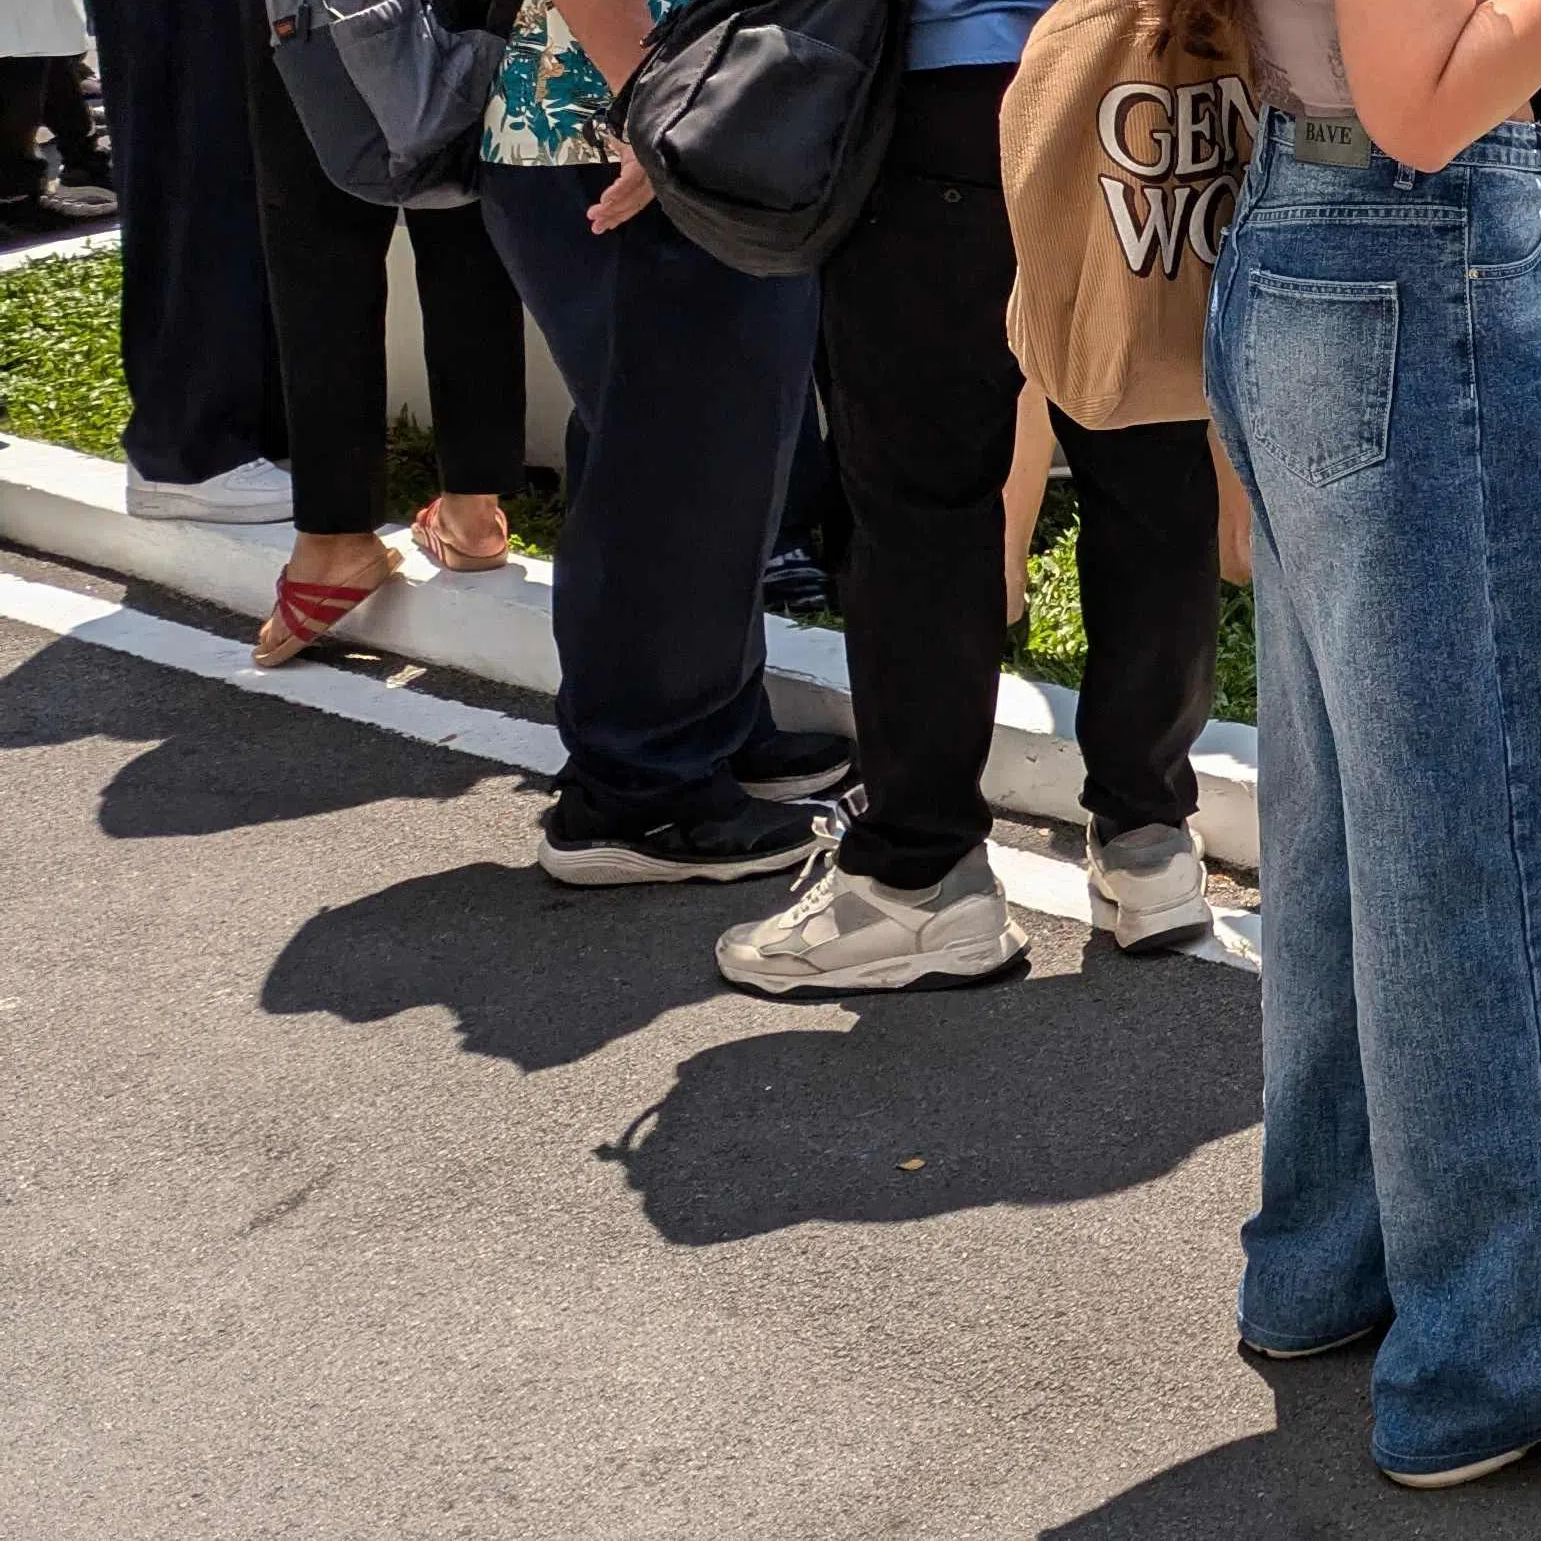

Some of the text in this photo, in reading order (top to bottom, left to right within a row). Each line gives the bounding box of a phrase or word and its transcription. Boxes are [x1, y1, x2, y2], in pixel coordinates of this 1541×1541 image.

[1096, 74, 1260, 180] GEN
[1305, 122, 1352, 145] BAVE
[1098, 174, 1242, 280] WO
